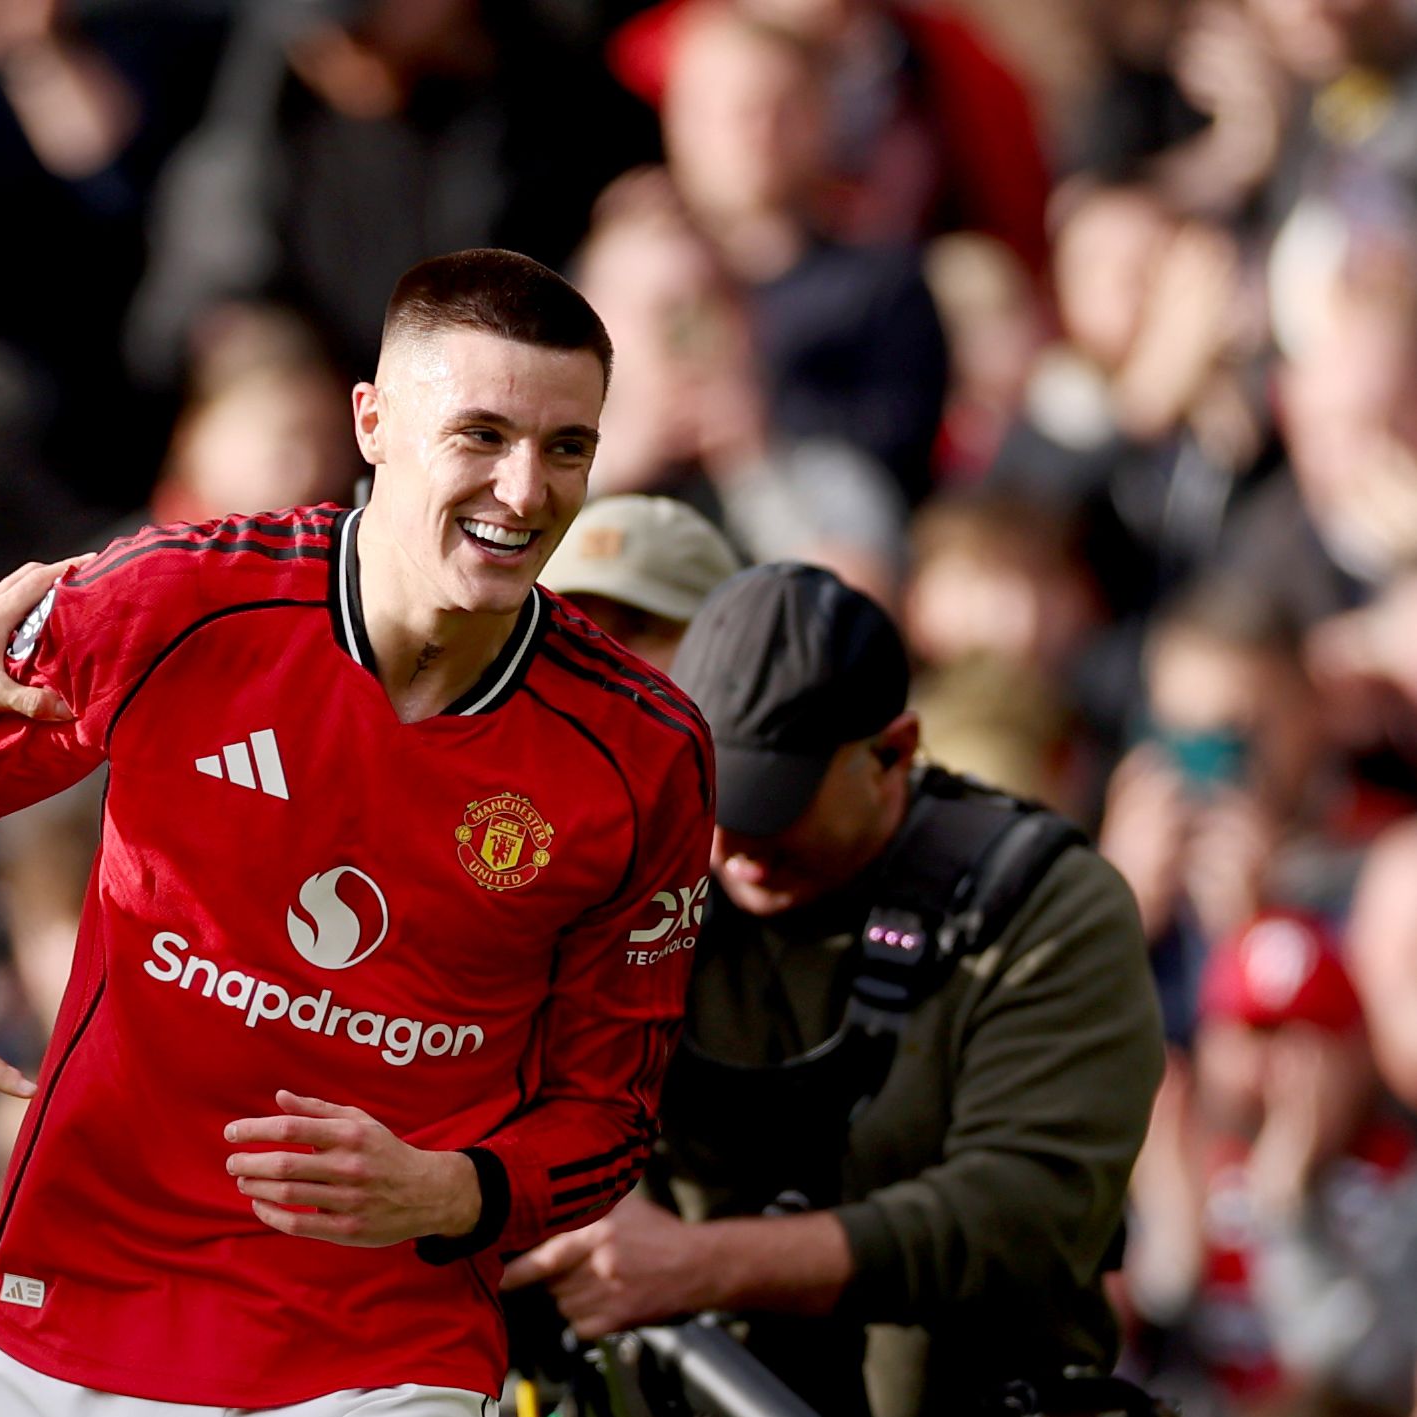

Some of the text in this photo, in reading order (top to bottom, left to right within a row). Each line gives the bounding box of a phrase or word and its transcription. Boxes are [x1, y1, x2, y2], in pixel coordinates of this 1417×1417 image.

[471, 799, 546, 842] MANCHESTER
[468, 861, 522, 885] UNITED
[626, 936, 696, 965] TECHNOLO
[143, 931, 485, 1067] Snapdragon
